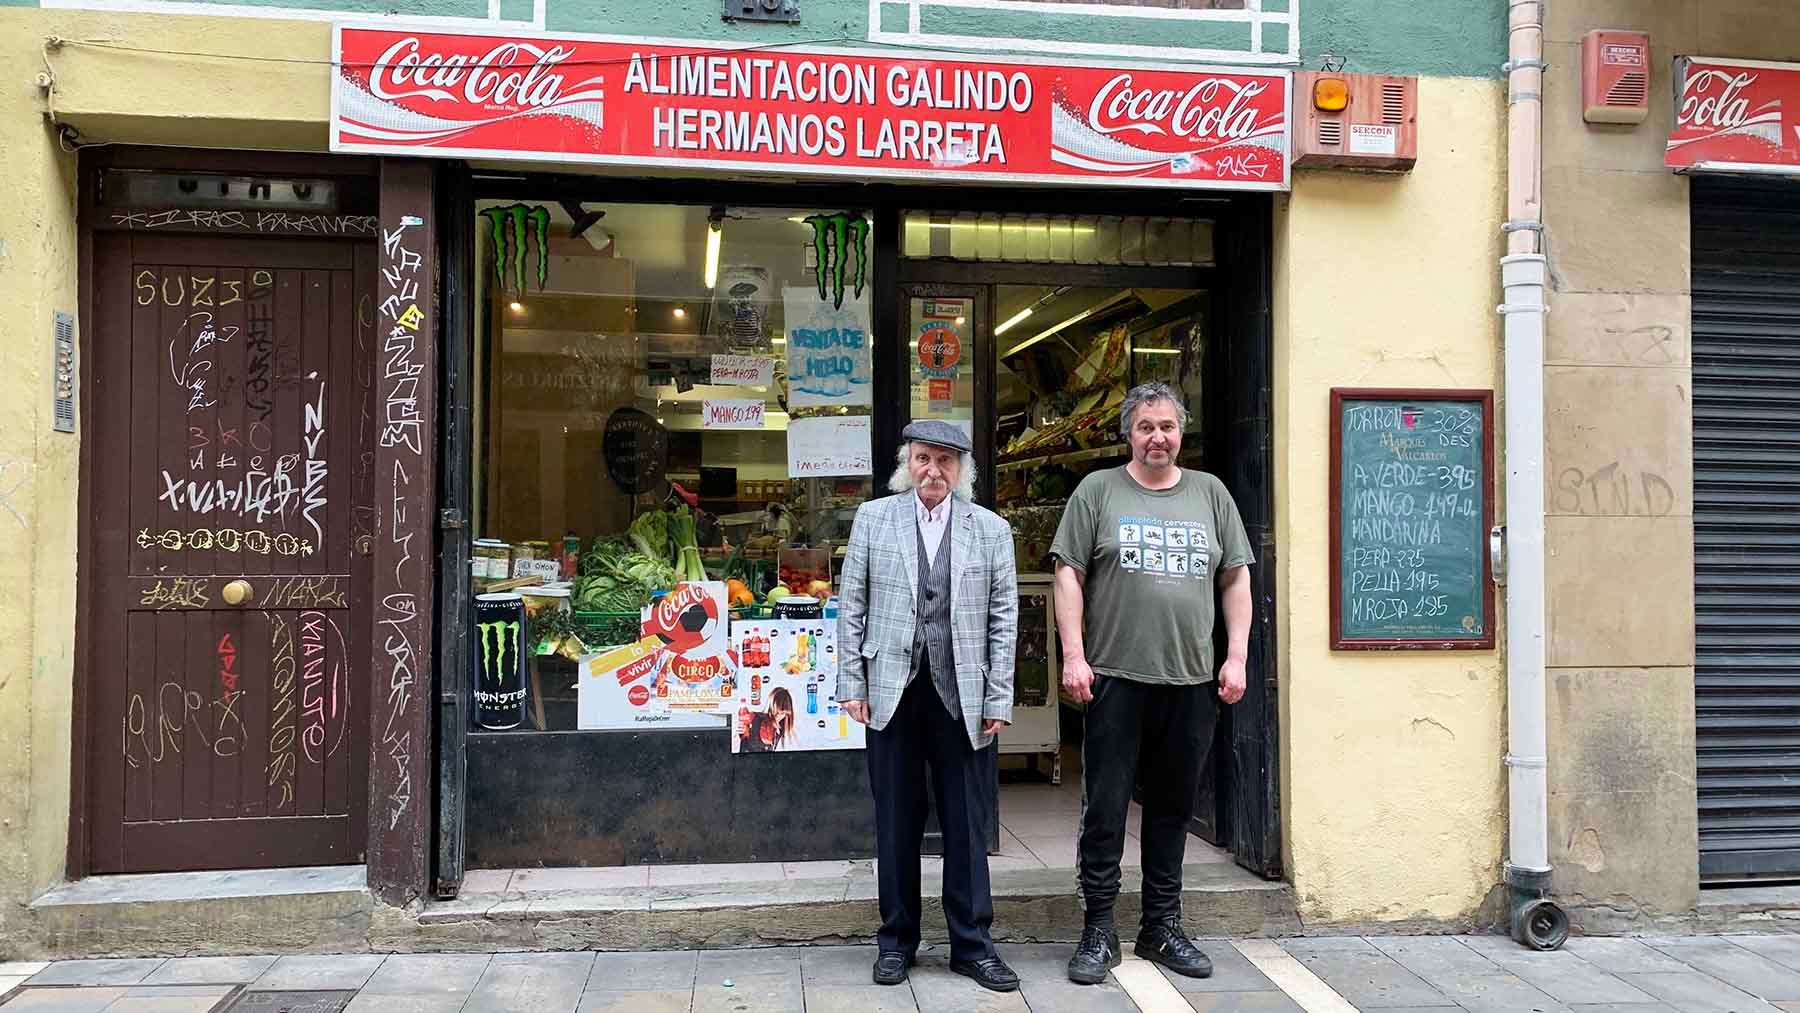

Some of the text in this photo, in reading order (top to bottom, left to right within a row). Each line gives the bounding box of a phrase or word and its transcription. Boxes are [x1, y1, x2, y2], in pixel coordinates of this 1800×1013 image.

[368, 37, 576, 107] Coca-Cola
[624, 52, 1033, 112] ALIMENTACION GALINDO
[1089, 74, 1269, 138] Coca-Cola
[653, 107, 1007, 163] HERMANOS LARRETA
[806, 355, 853, 378] HIELO
[711, 406, 744, 423] MANGO
[1353, 488, 1415, 517] MANGO
[628, 658, 652, 677] vivir
[677, 664, 715, 679] CIRCO
[474, 687, 528, 704] MONSTER
[479, 702, 523, 711] ENERGY
